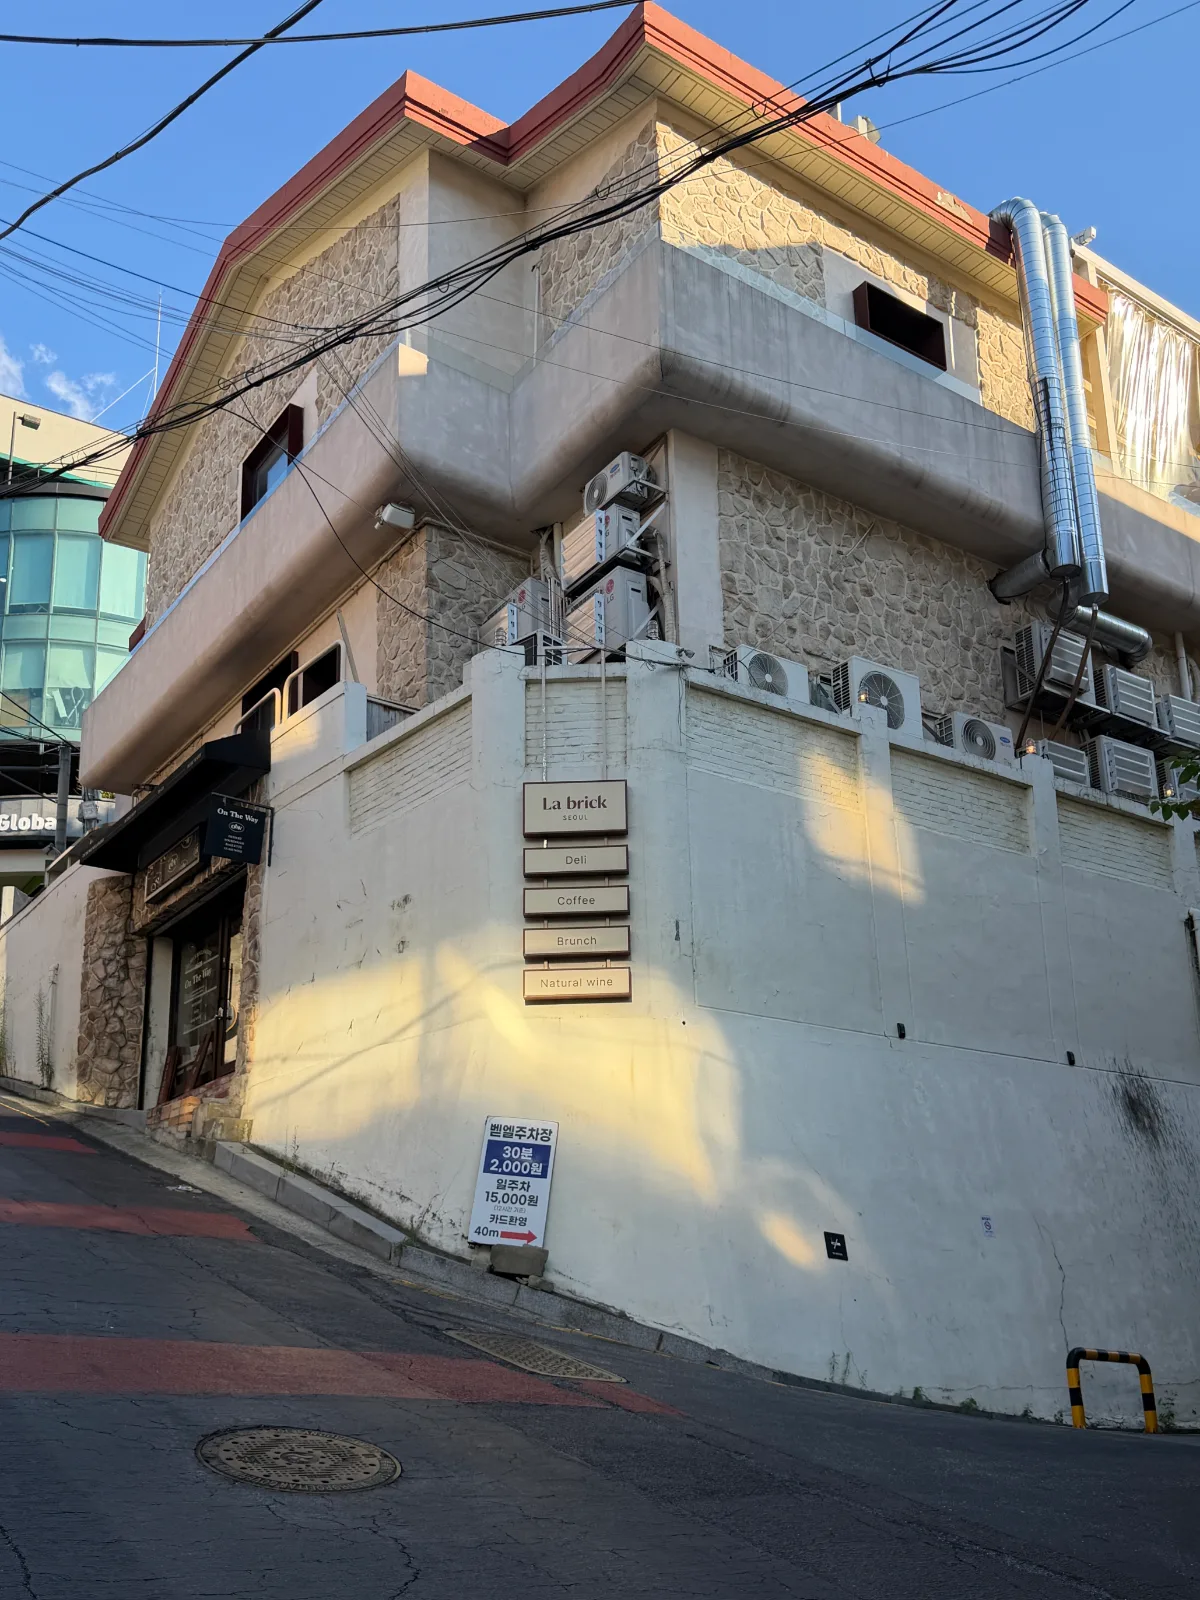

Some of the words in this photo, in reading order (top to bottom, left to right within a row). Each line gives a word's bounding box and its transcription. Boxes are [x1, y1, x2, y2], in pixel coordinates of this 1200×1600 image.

[606, 593, 615, 604] LG
[543, 797, 562, 811] La
[566, 795, 608, 810] brick
[0, 813, 57, 831] Globa
[217, 807, 229, 816] On
[229, 810, 244, 820] The
[244, 814, 259, 824] Way
[565, 855, 587, 865] Deli
[557, 895, 596, 906] Coffee
[557, 935, 597, 946] Brunch
[540, 977, 582, 988] Natural
[586, 977, 613, 987] wine
[490, 1123, 553, 1142] 벧엘주차장
[502, 1145, 533, 1160] 30분
[489, 1158, 543, 1176] 2,000원
[496, 1178, 531, 1192] 일주차
[485, 1190, 539, 1207] 15,000원
[489, 1213, 528, 1227] 카드환영
[474, 1225, 500, 1238] 40m
